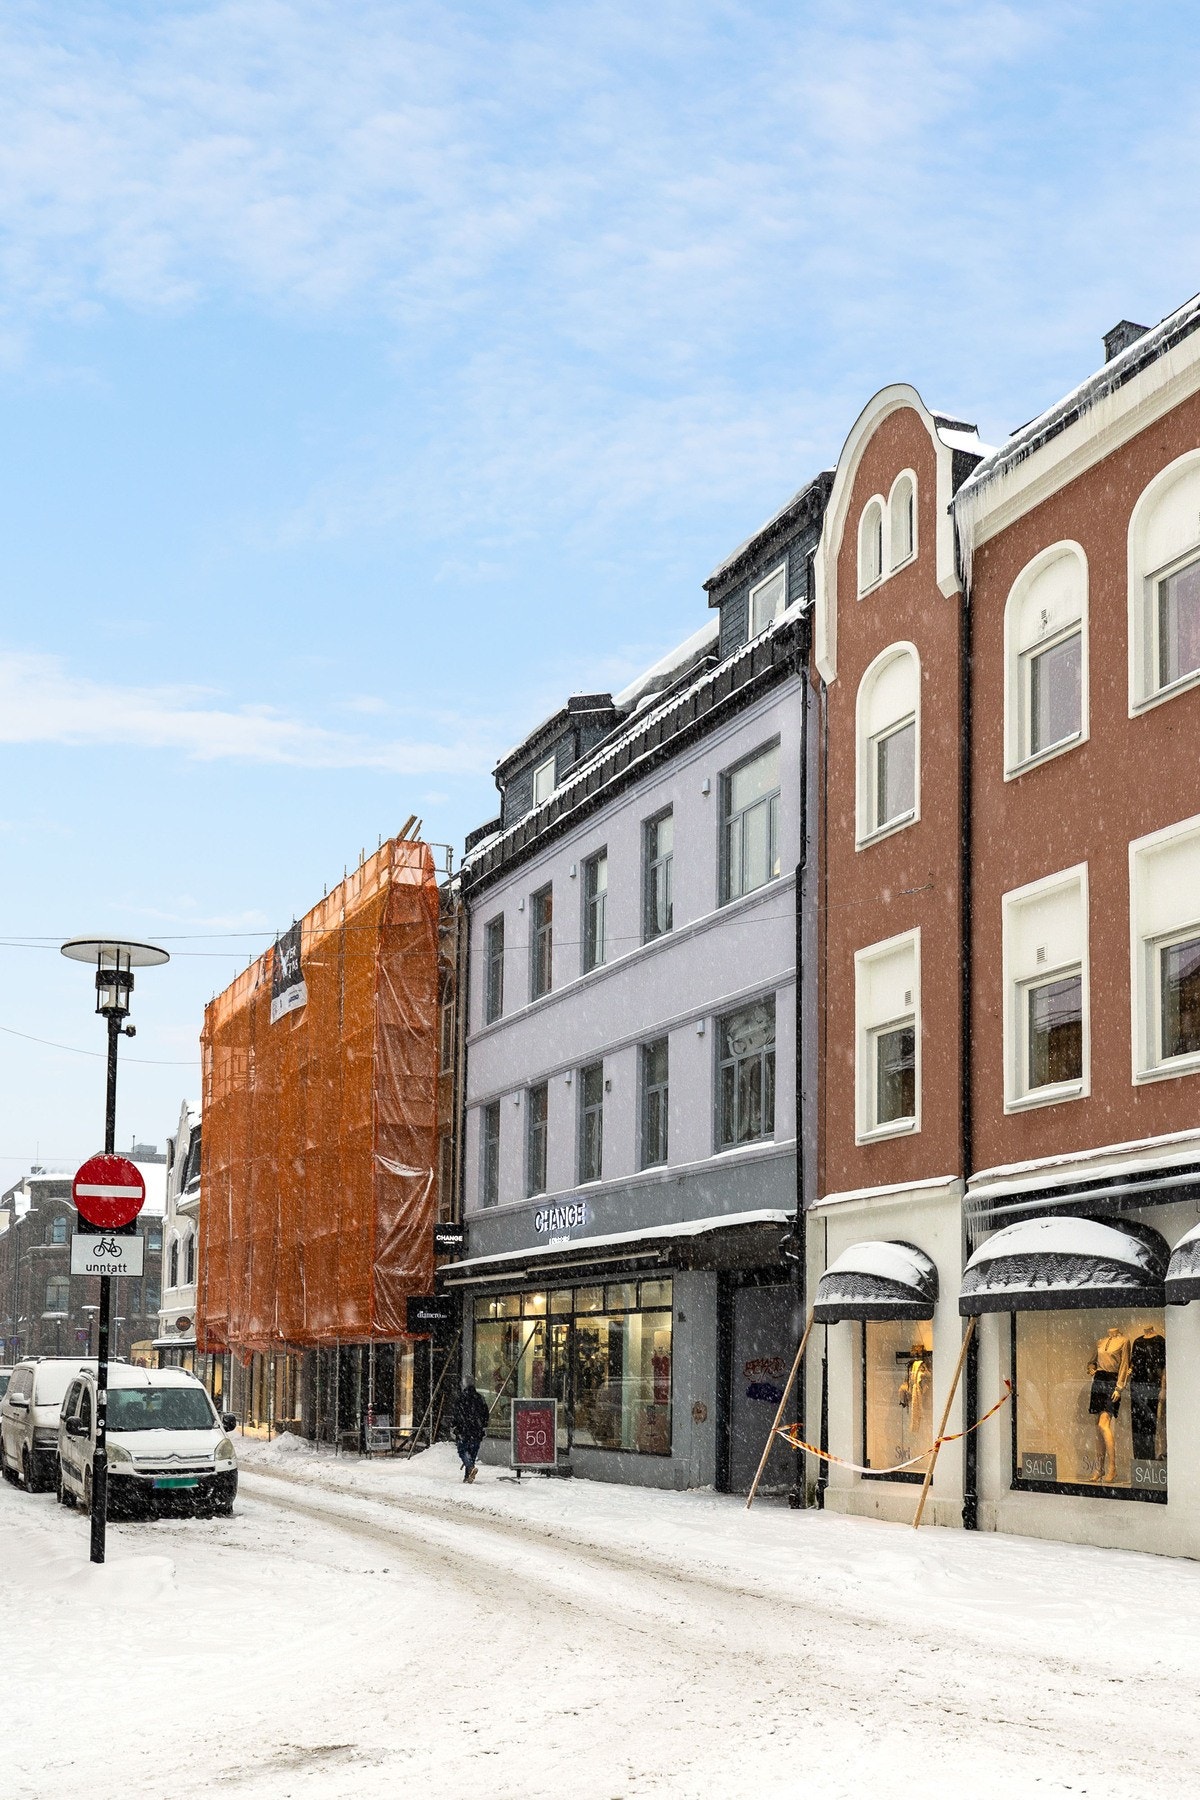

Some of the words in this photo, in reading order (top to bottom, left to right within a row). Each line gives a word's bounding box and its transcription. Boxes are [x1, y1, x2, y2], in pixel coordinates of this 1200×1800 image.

[535, 1203, 586, 1233] CHANGE
[436, 1234, 463, 1242] CHANGE
[85, 1263, 128, 1273] unntatt
[525, 1430, 547, 1446] 50
[1025, 1459, 1053, 1475] SALG
[1135, 1466, 1167, 1485] SALG
